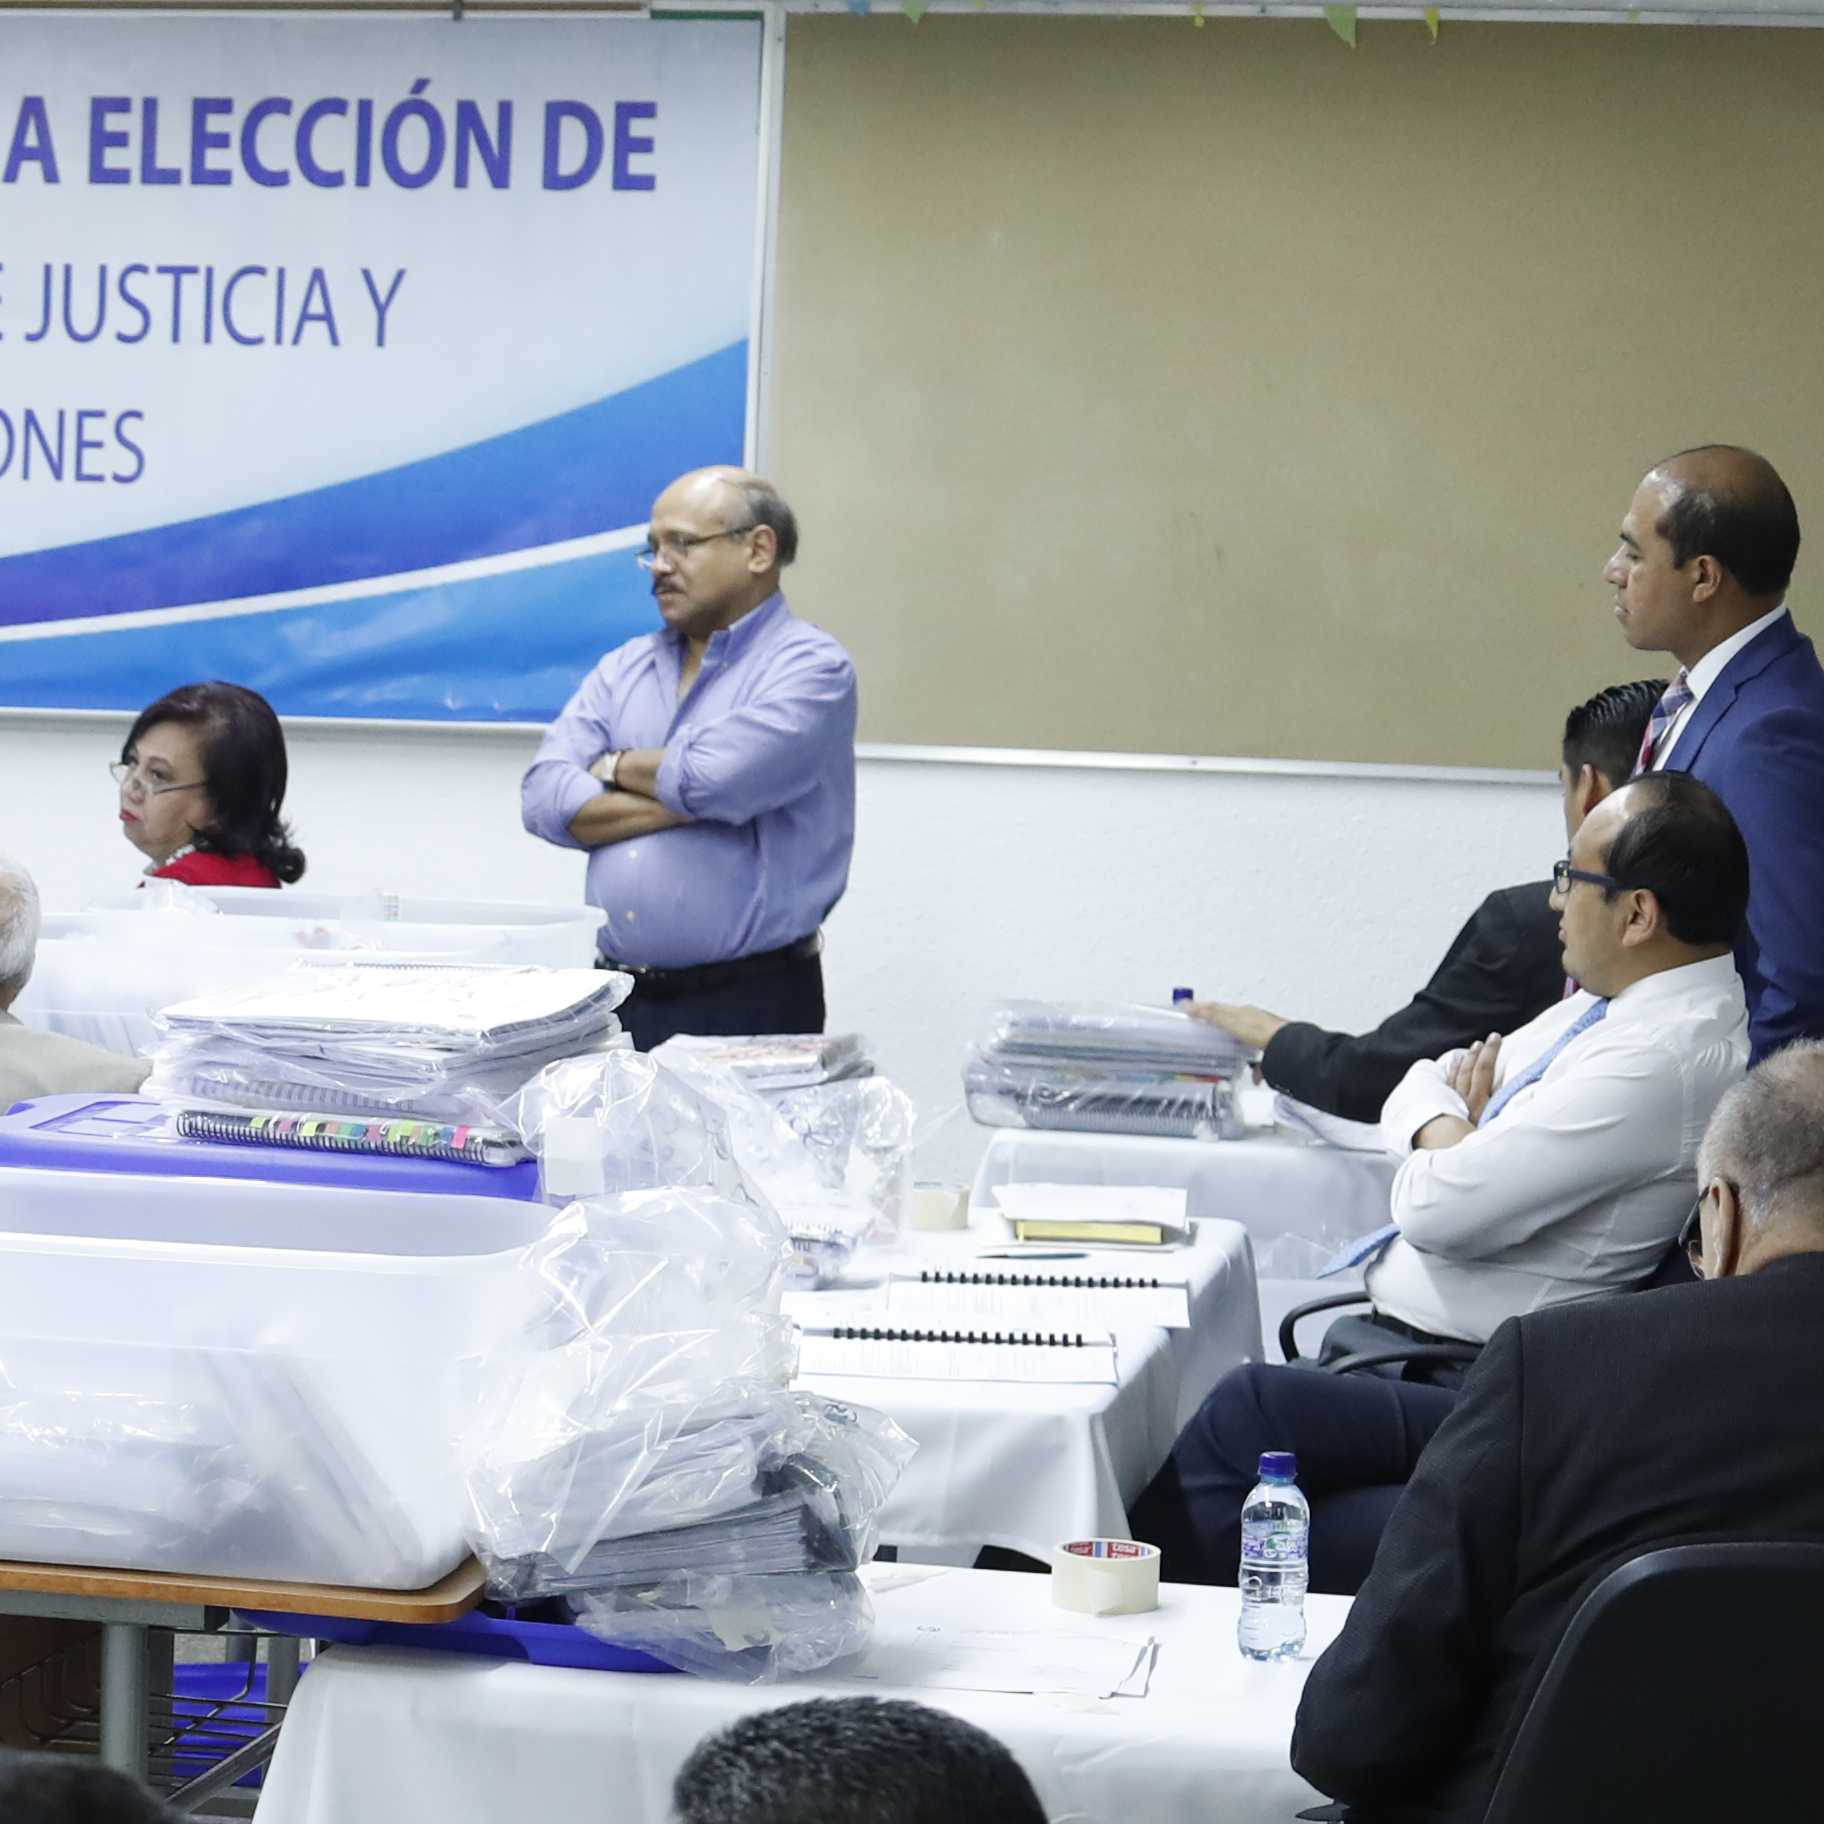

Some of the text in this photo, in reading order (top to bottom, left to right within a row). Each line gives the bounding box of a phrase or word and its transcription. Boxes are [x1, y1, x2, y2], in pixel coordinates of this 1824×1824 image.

[89, 78, 513, 190] ELECCIÓN
[542, 100, 658, 192] DE
[25, 263, 340, 347] JUSTICIA
[362, 269, 406, 348] Y
